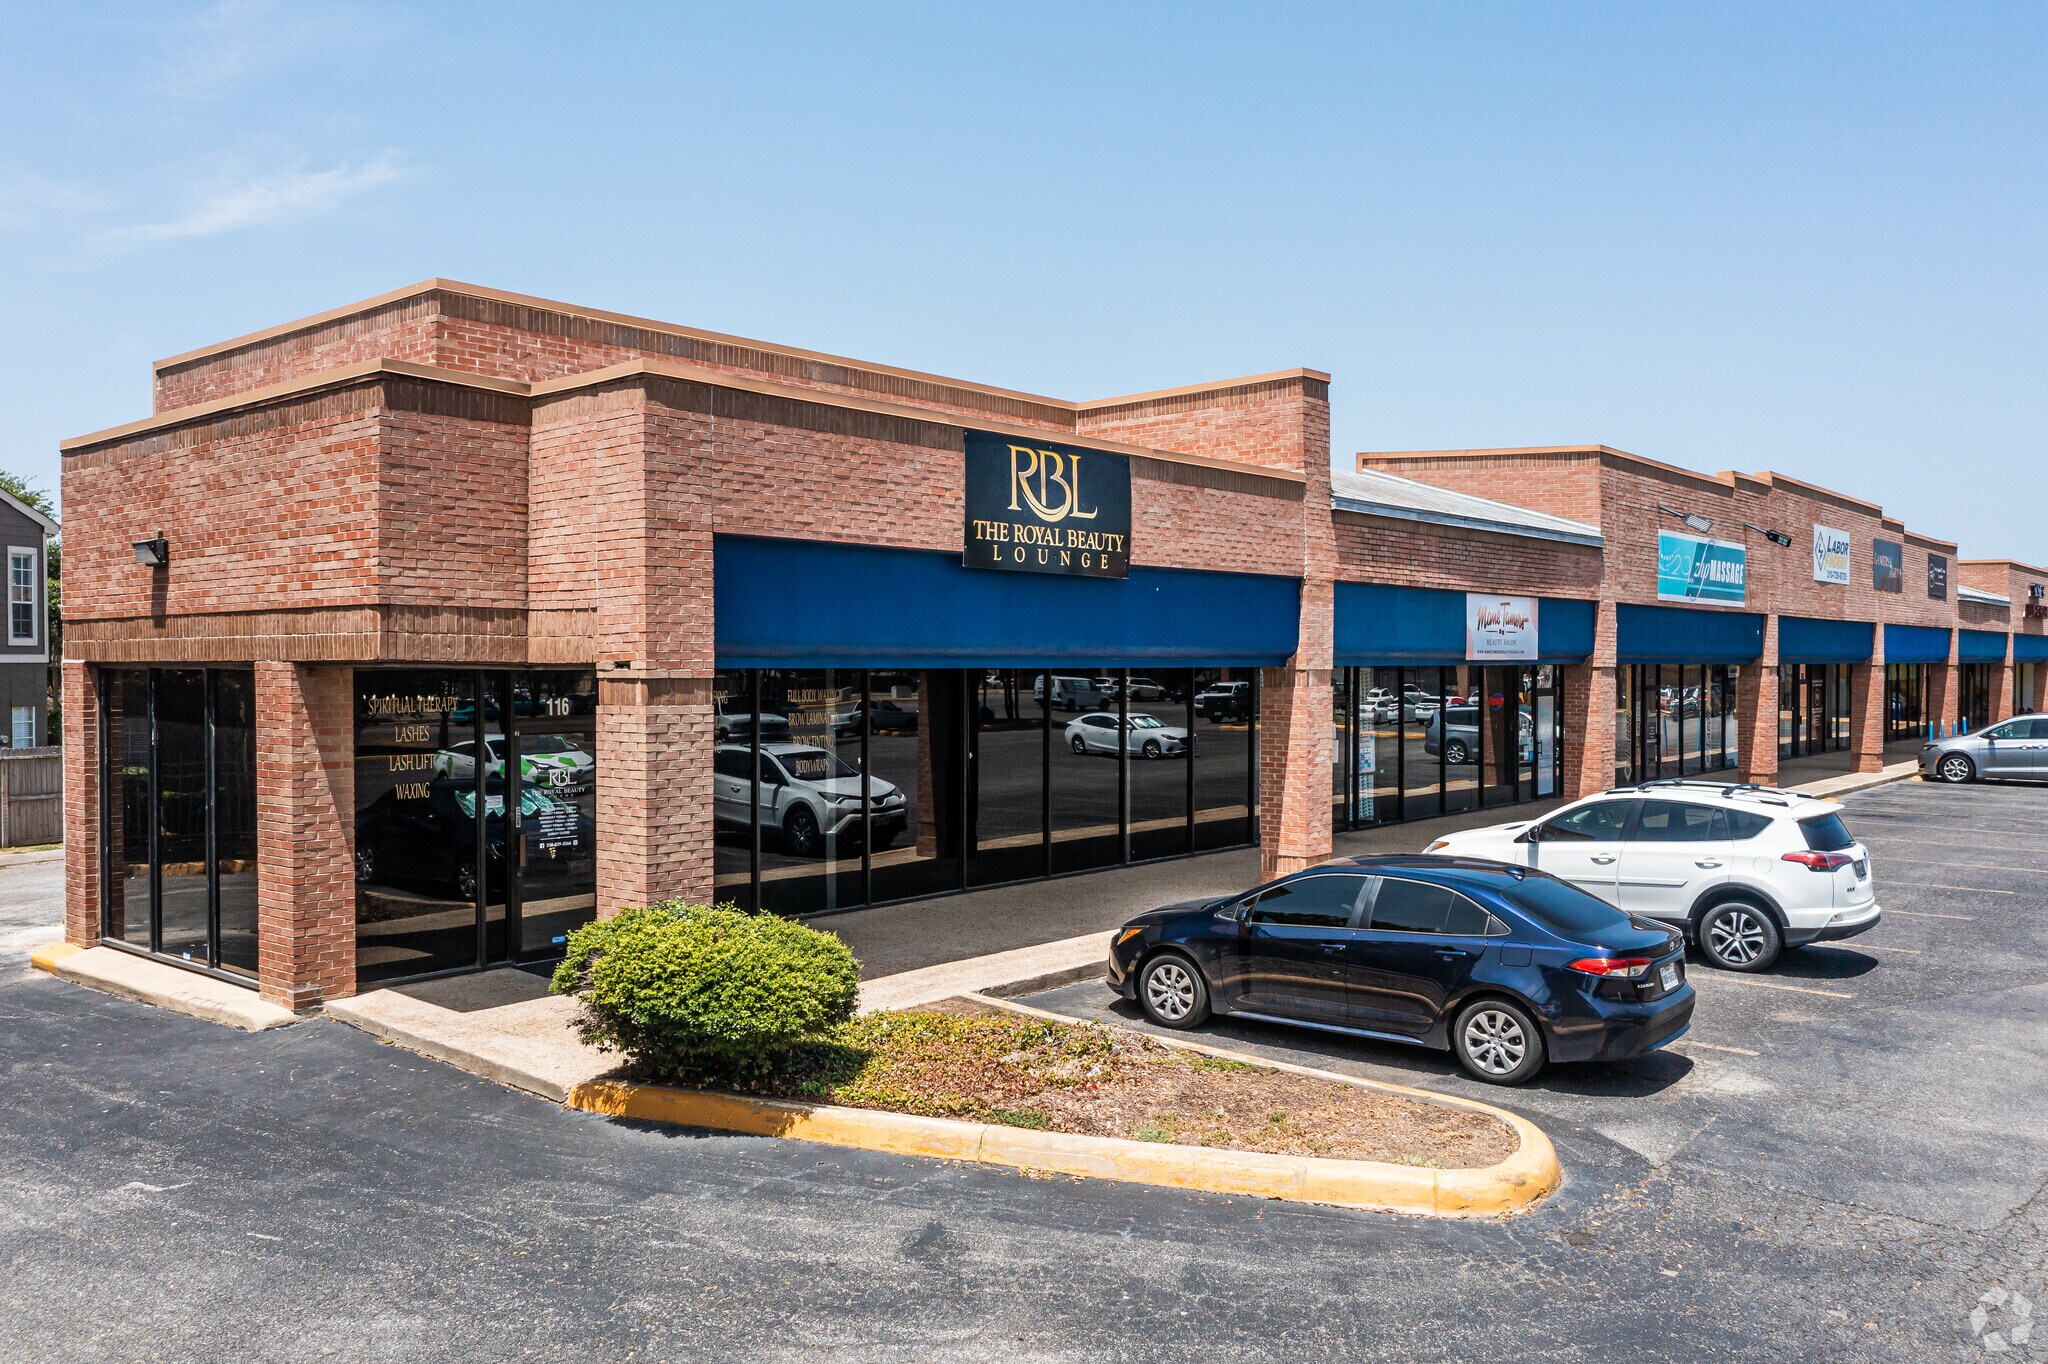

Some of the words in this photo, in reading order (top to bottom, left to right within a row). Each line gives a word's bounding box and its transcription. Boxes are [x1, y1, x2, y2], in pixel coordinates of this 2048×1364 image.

[1007, 444, 1098, 523] RBL
[973, 519, 1010, 542] THE
[1013, 523, 1064, 547] ROYAL
[1067, 529, 1125, 553] BEAUTY
[1827, 535, 1849, 556] LABOR
[993, 544, 1109, 570] LOUNGE
[1709, 559, 1744, 585] MASSAGE
[1477, 606, 1500, 631] Mane
[368, 698, 417, 714] SPIRITUAL
[418, 696, 458, 712] THERAPY
[546, 697, 569, 716] 116
[788, 711, 805, 726] BROW
[395, 726, 430, 742] LASHES
[389, 755, 414, 771] LASH
[415, 753, 435, 770] LIFT
[548, 769, 577, 786] RBL
[395, 782, 430, 800] WAXING
[564, 786, 586, 794] BEAUTY
